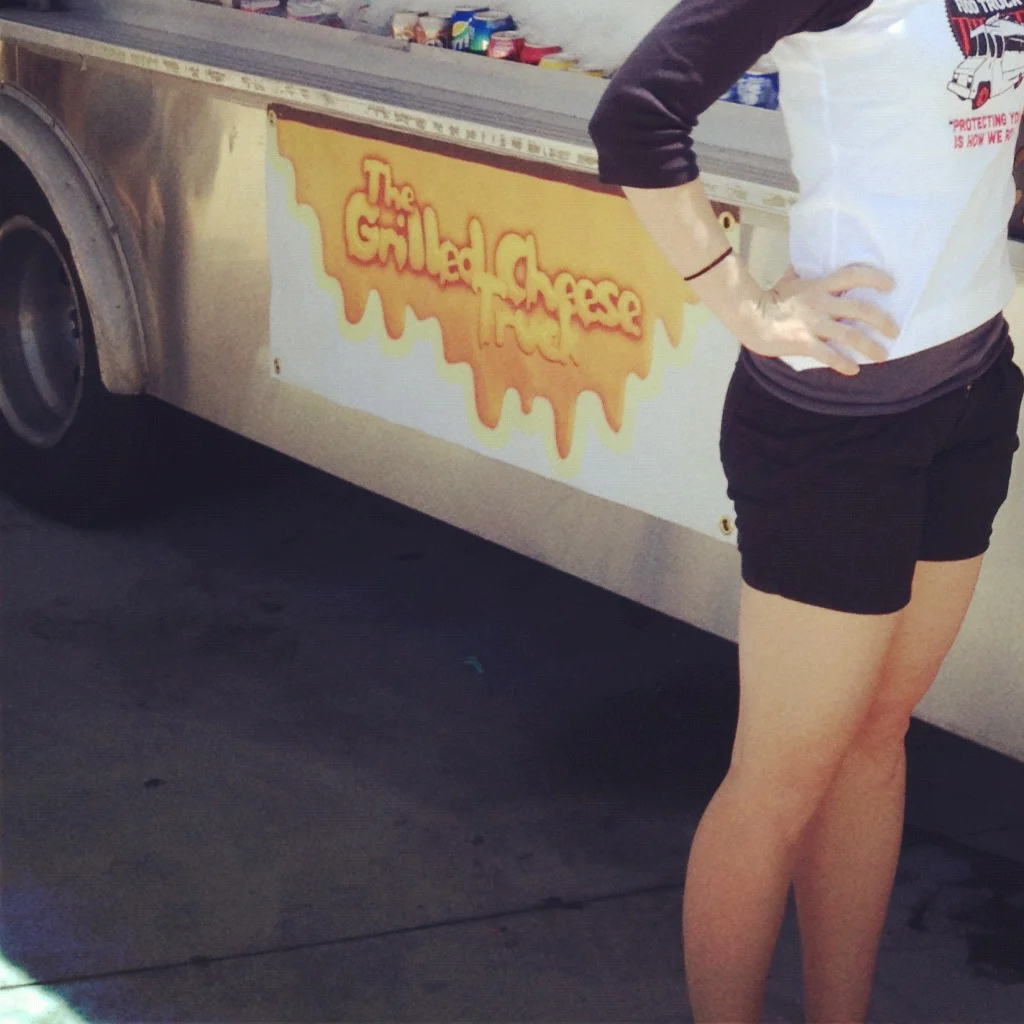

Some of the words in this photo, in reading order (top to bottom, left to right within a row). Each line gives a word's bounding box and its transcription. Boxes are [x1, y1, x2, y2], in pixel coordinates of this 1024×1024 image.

[954, 135, 964, 149] IS
[967, 133, 984, 147] HOW
[988, 130, 1002, 144] WE
[363, 157, 417, 213] The
[344, 189, 486, 285] Grilled
[495, 230, 645, 340] Cheese
